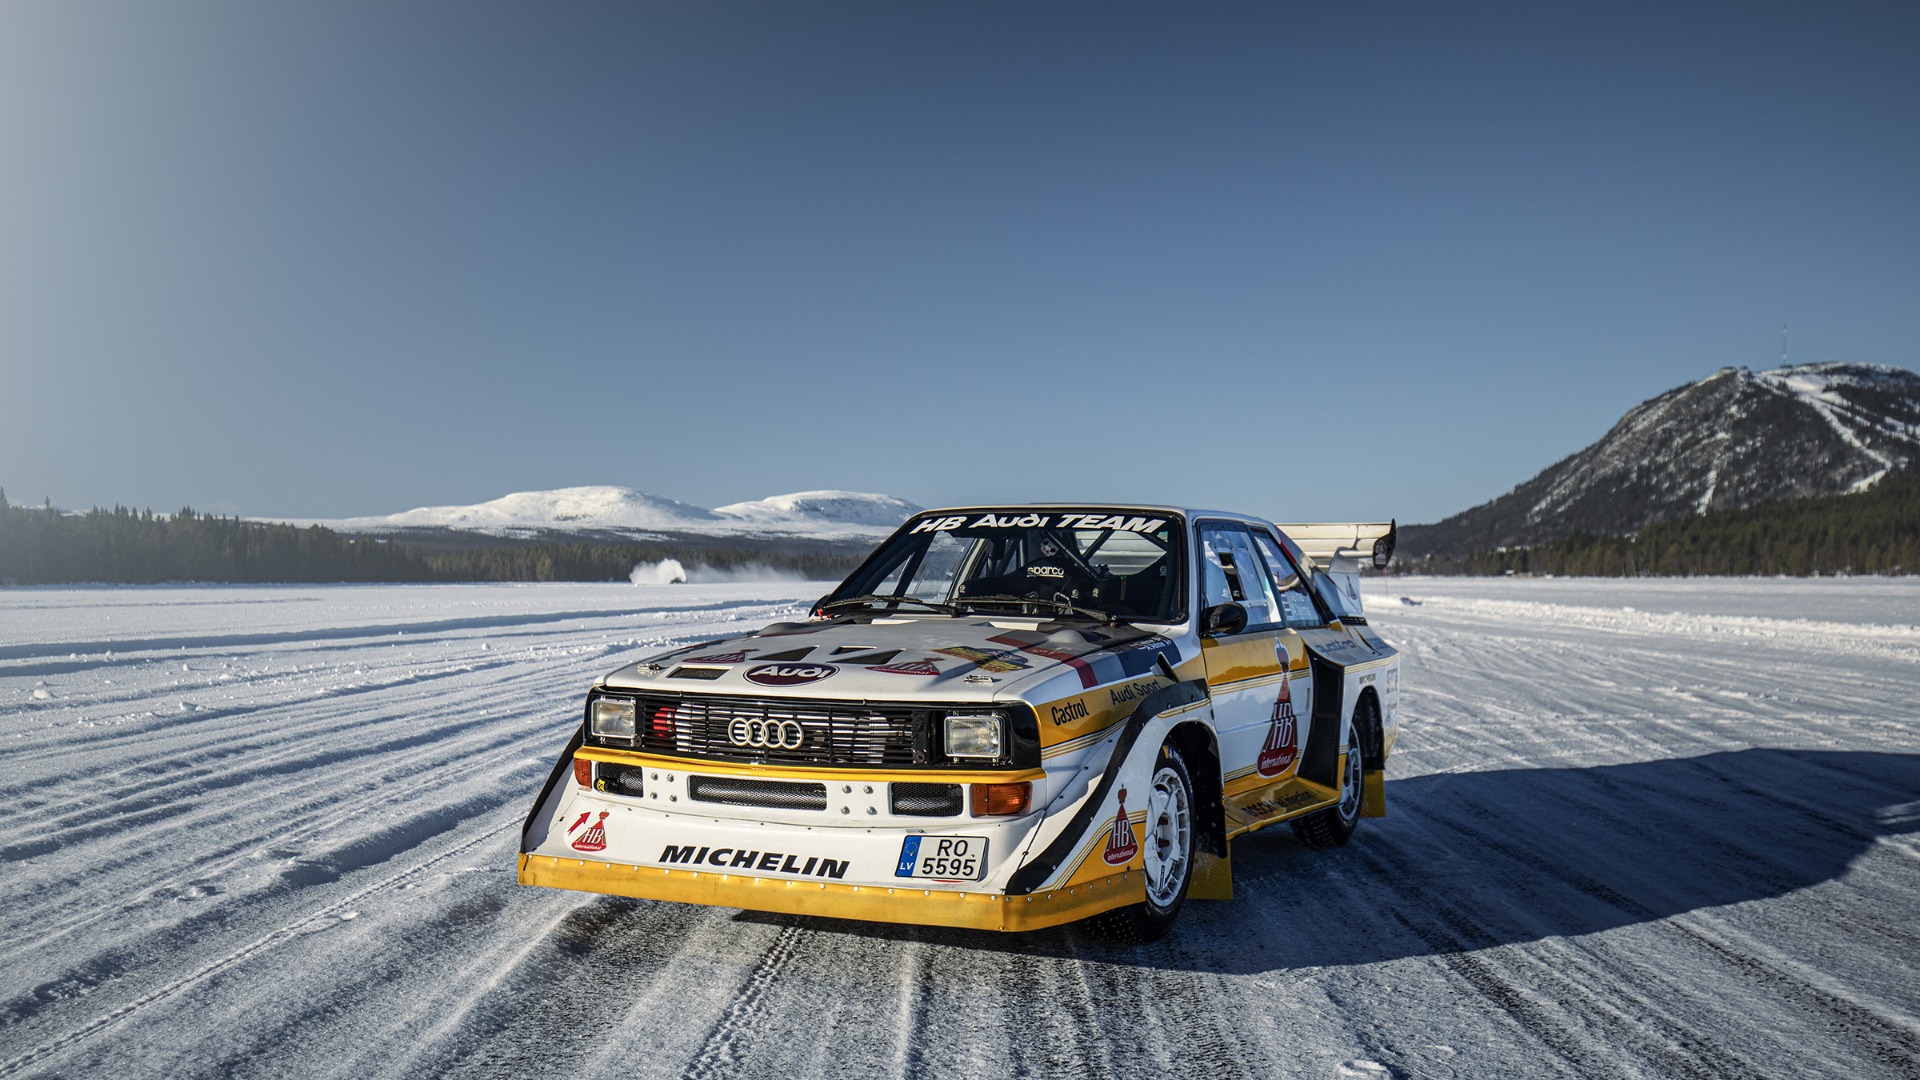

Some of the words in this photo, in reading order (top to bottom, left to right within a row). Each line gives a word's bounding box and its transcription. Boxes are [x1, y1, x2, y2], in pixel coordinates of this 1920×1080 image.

[910, 515, 967, 534] HB
[968, 513, 1050, 529] Audi
[1055, 514, 1168, 534] TEAM
[1027, 566, 1065, 576] sparco
[751, 665, 832, 678] Audi
[1110, 682, 1135, 706] Audi
[1137, 679, 1162, 697] Sport
[1051, 698, 1090, 727] Castrol
[1271, 702, 1294, 750] HB
[1261, 753, 1293, 770] international
[582, 828, 605, 844] HB
[1112, 819, 1130, 849] HB
[936, 839, 969, 857] RO
[1107, 848, 1134, 861] international
[658, 844, 851, 879] MICHELIN
[900, 862, 914, 871] LV
[922, 857, 976, 877] 5595
